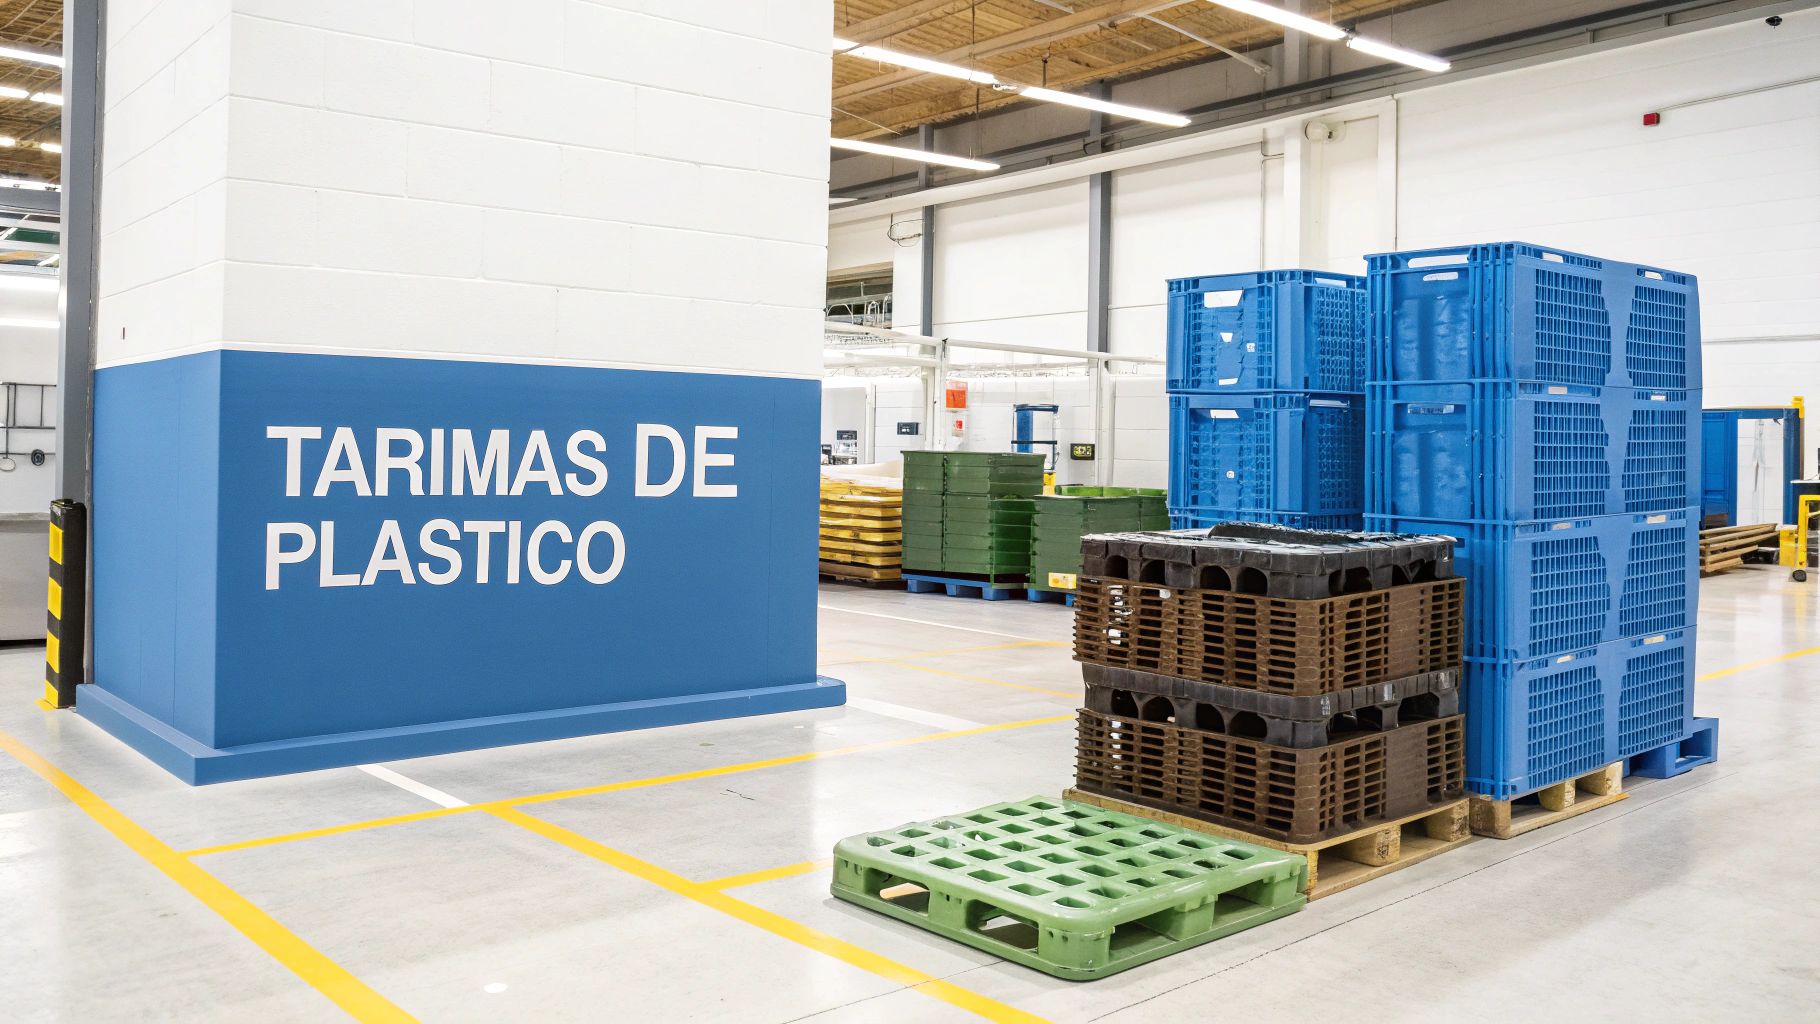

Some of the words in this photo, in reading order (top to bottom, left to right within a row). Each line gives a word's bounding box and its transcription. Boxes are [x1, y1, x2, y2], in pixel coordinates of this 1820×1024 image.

[266, 425, 608, 497] TARIMAS
[634, 423, 739, 498] DE
[265, 518, 626, 591] PLASTICO
